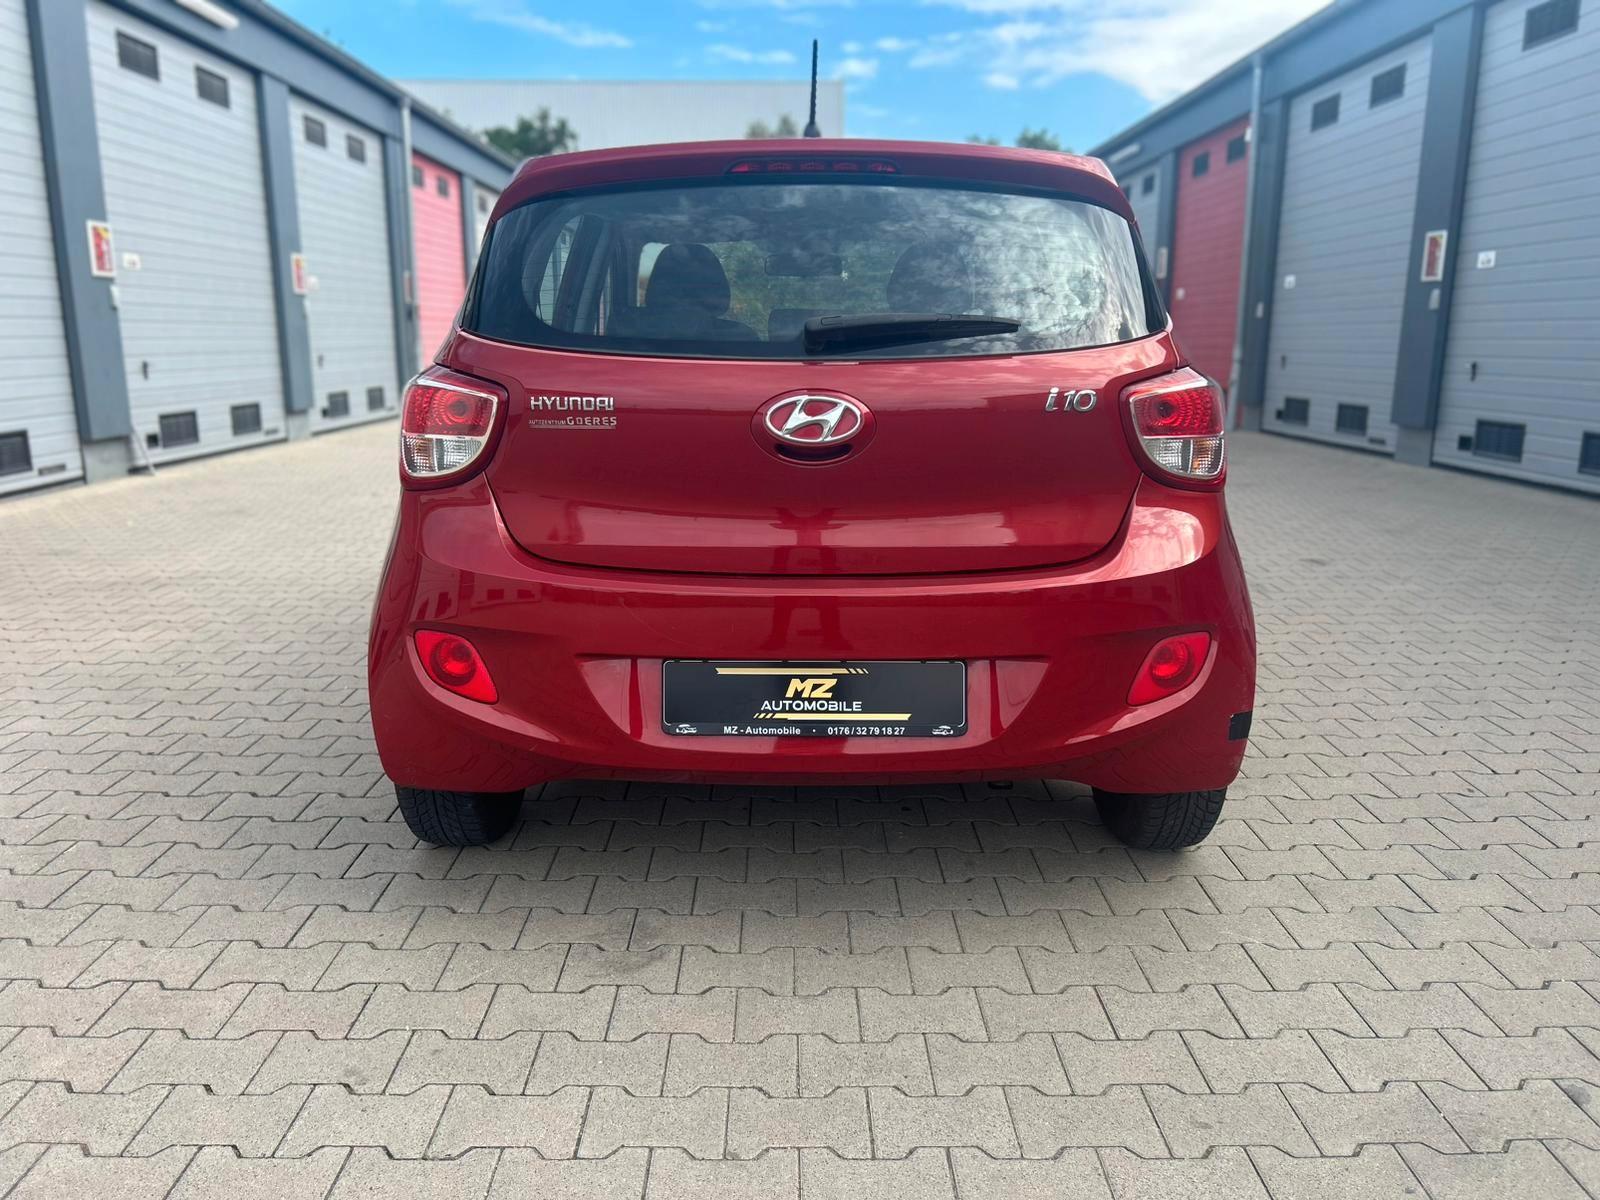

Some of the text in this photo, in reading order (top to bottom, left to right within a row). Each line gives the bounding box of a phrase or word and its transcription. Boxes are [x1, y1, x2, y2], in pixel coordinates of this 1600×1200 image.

[530, 396, 614, 411] HYUNDAI
[1045, 387, 1097, 412] i10
[566, 416, 617, 426] GOERES
[785, 678, 838, 698] MZ
[760, 700, 863, 711] AUTOMOBILE
[723, 726, 738, 735] MZ
[745, 726, 801, 735] Automobile
